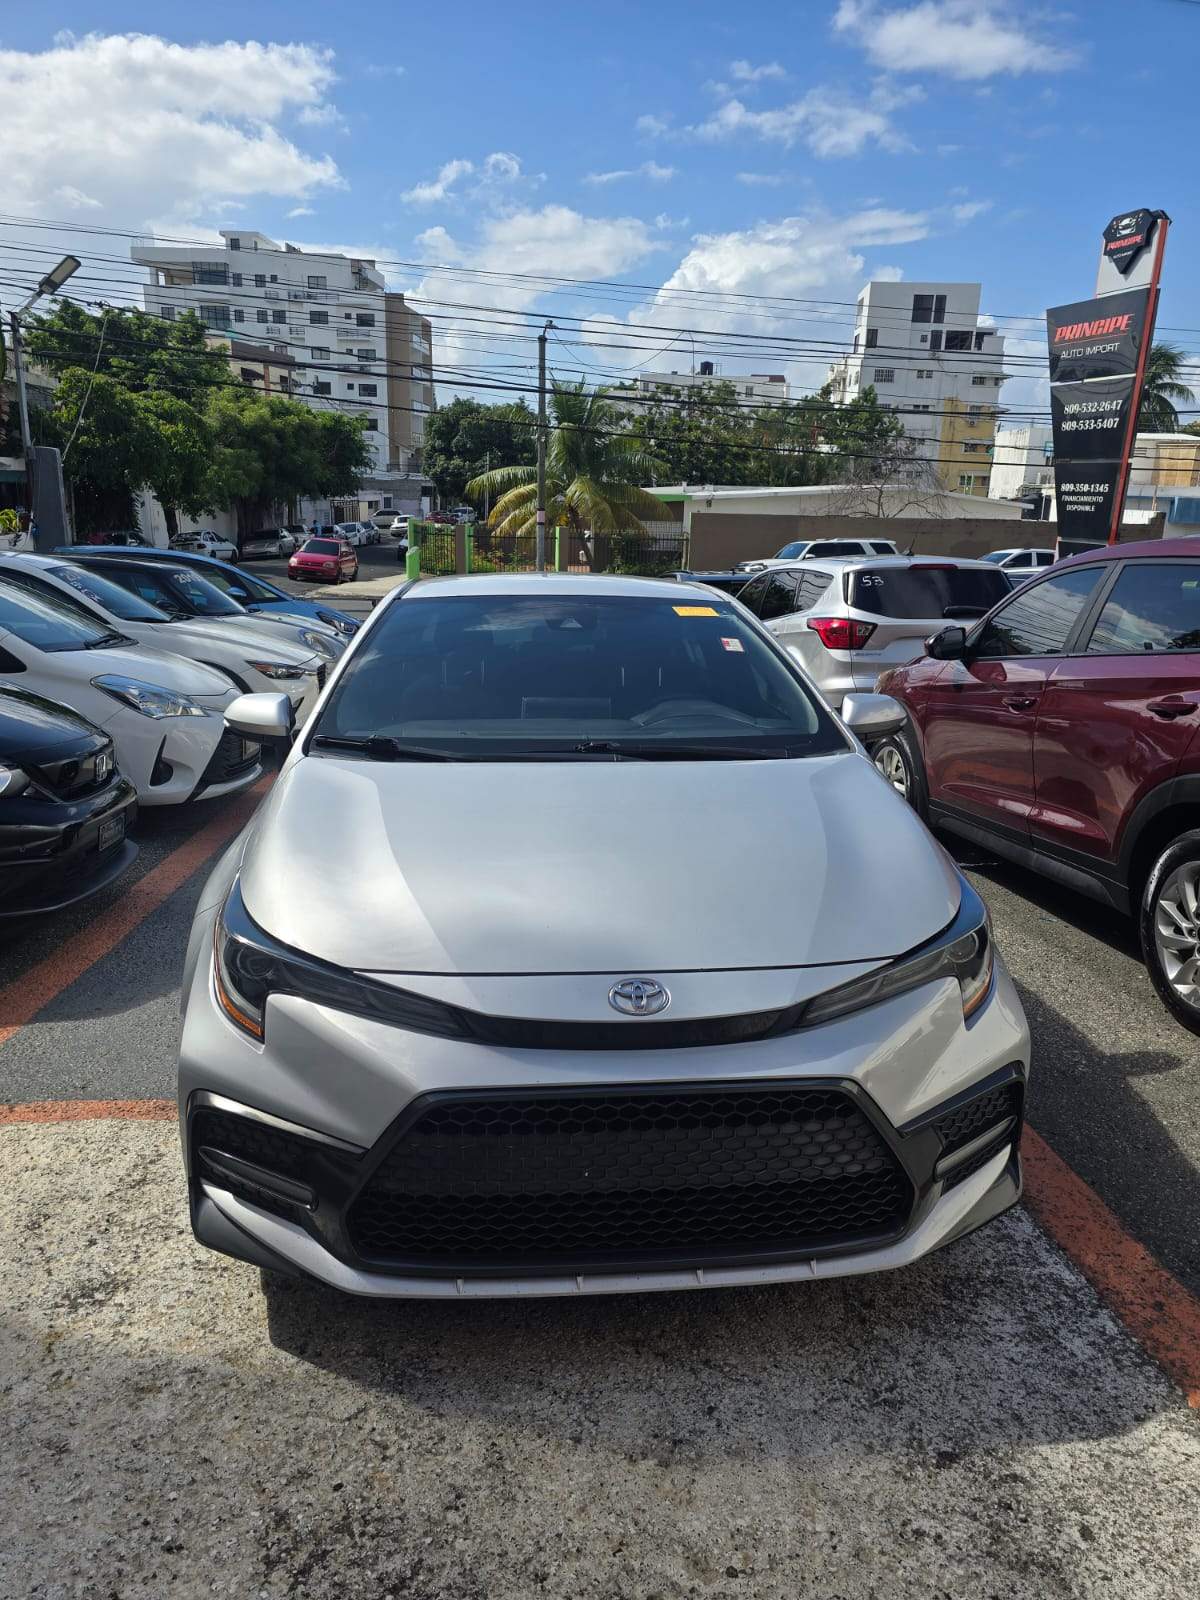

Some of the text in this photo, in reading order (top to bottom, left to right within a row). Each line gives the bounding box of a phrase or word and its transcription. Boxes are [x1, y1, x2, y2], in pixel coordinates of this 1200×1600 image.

[1055, 314, 1134, 342] PRINCIPE
[1061, 343, 1120, 359] AUTO IMPORT
[1064, 400, 1122, 414] 809-532-2647
[1061, 418, 1119, 431] 809-533-5407
[1060, 484, 1109, 492] 809-350-1345
